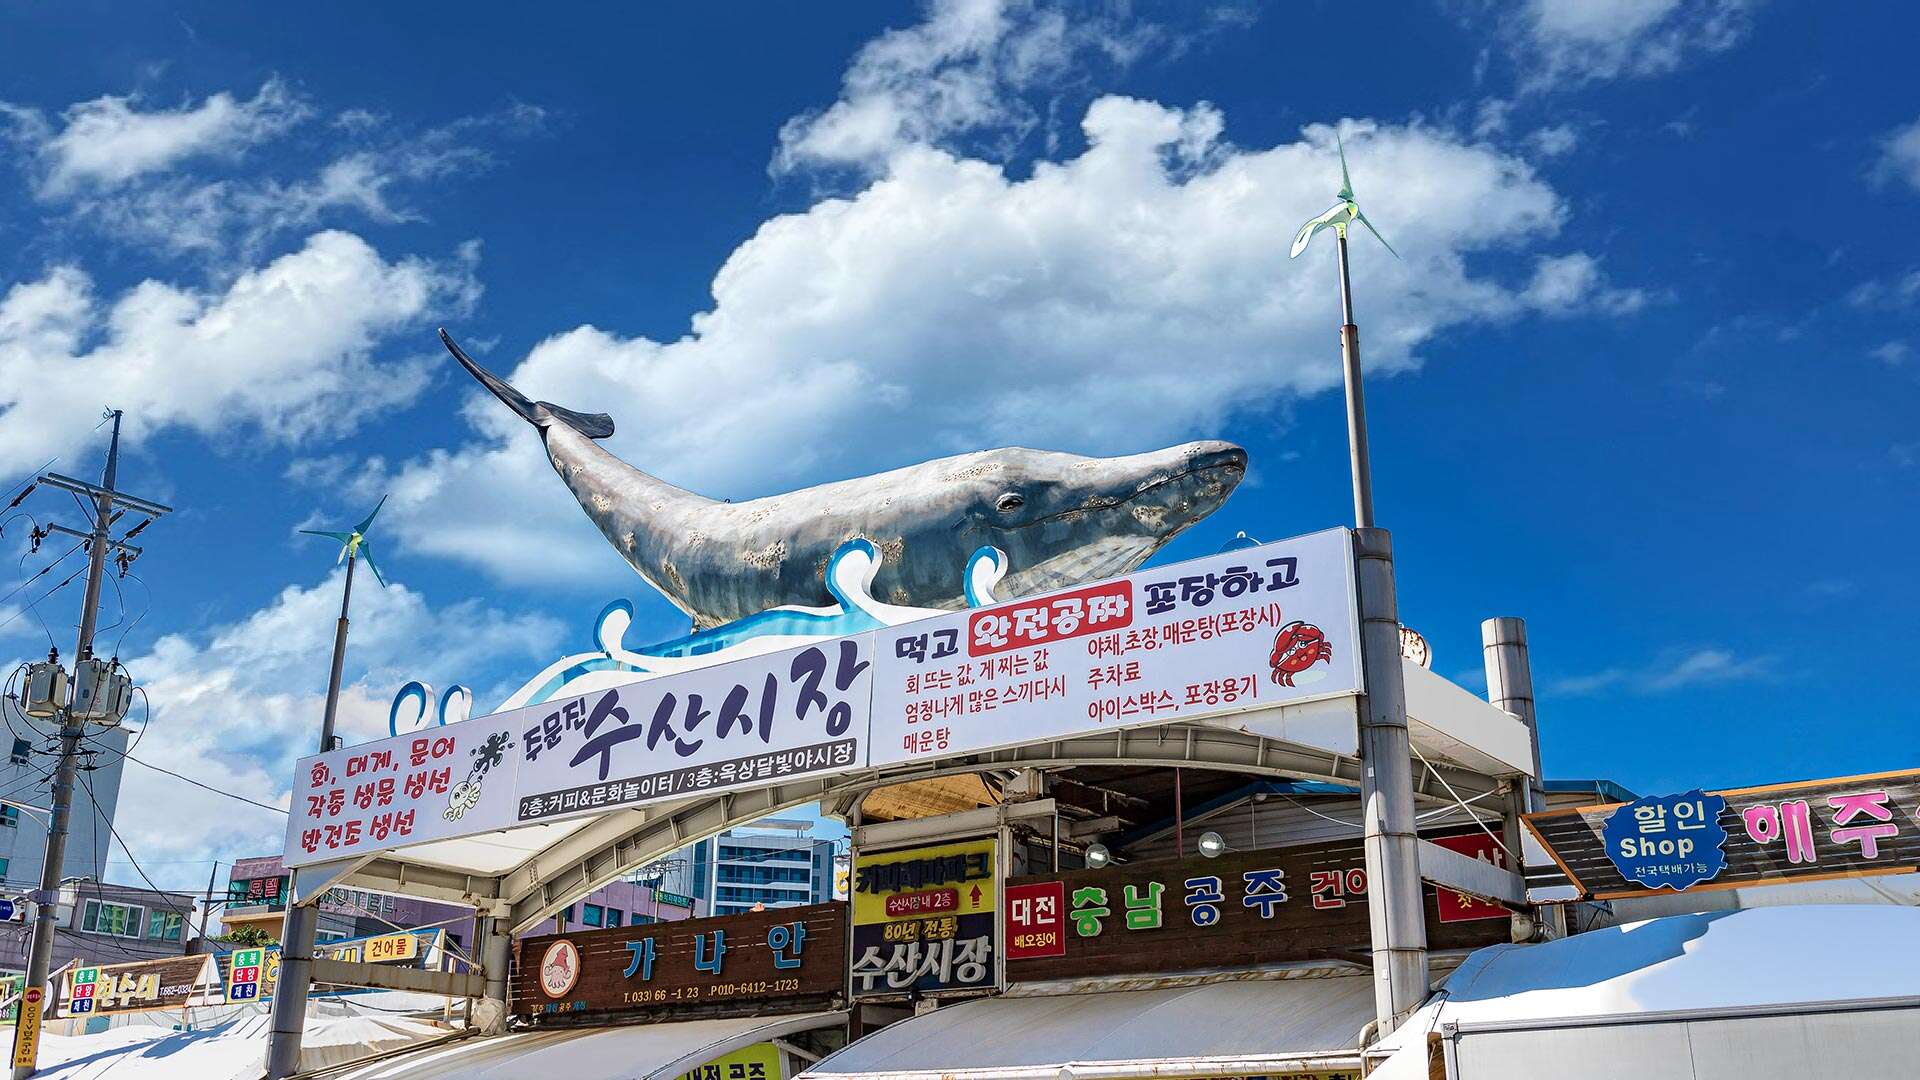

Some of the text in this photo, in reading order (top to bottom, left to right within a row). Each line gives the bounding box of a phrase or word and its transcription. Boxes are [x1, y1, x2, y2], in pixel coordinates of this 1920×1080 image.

[895, 557, 1300, 664] 먹고 완전공짜 포장하고
[905, 648, 1049, 694] 회 뜨는 값, 게 찌는 값
[1087, 662, 1142, 690] 주차료
[523, 640, 870, 781] 주문진 수산시장
[905, 675, 1066, 724] 엄청나게 많은 스끼다시
[1088, 674, 1258, 722] 아이스박스, 포장용기
[904, 727, 950, 754] 매운탕
[311, 762, 337, 788] 회,
[410, 737, 456, 766] 문어
[307, 767, 451, 819] 각종 생물 생선
[301, 809, 416, 853] 반건조 생선
[1634, 801, 1706, 834] 할인
[1742, 790, 1920, 864] 해주
[1620, 836, 1694, 859] Shop
[1635, 862, 1707, 878] 전국택배가능
[889, 892, 951, 911] 수산시장 내 2층
[1011, 895, 1056, 926] 대전
[1070, 881, 1165, 937] 충남
[1184, 868, 1288, 926] 공주
[884, 916, 956, 940] 80년 전통
[1014, 932, 1056, 949] 배오징어
[372, 938, 407, 957] 건어물
[852, 935, 991, 990] 수산시장
[76, 985, 93, 997] 단양
[236, 969, 256, 982] 단양
